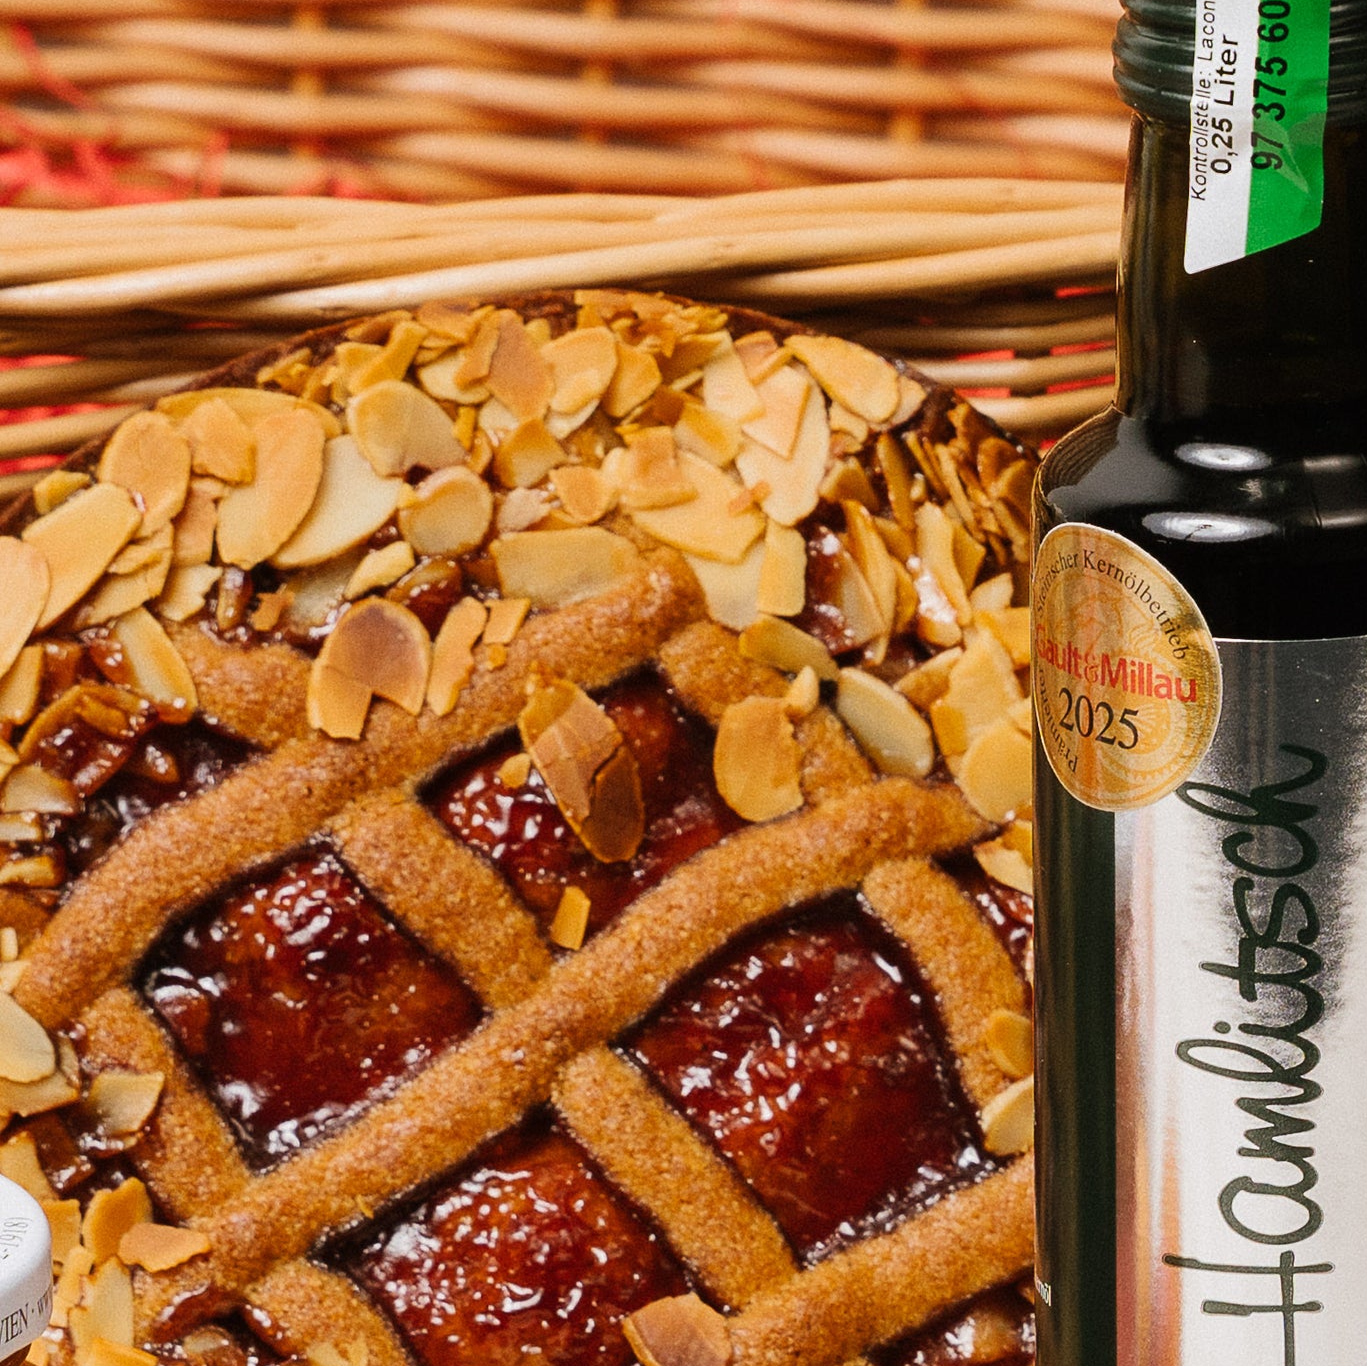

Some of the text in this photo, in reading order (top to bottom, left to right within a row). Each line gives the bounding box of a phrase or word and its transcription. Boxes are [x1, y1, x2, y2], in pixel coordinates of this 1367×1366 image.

[1197, 0, 1216, 61] Lacon
[1210, 34, 1239, 174] 0,25 Liter
[1252, 56, 1288, 122] 375
[1191, 71, 1211, 201] Kontrollstelle:
[1250, 131, 1284, 170] 97
[1083, 549, 1188, 660] Kernölbetrieb
[1059, 687, 1139, 750] 2025
